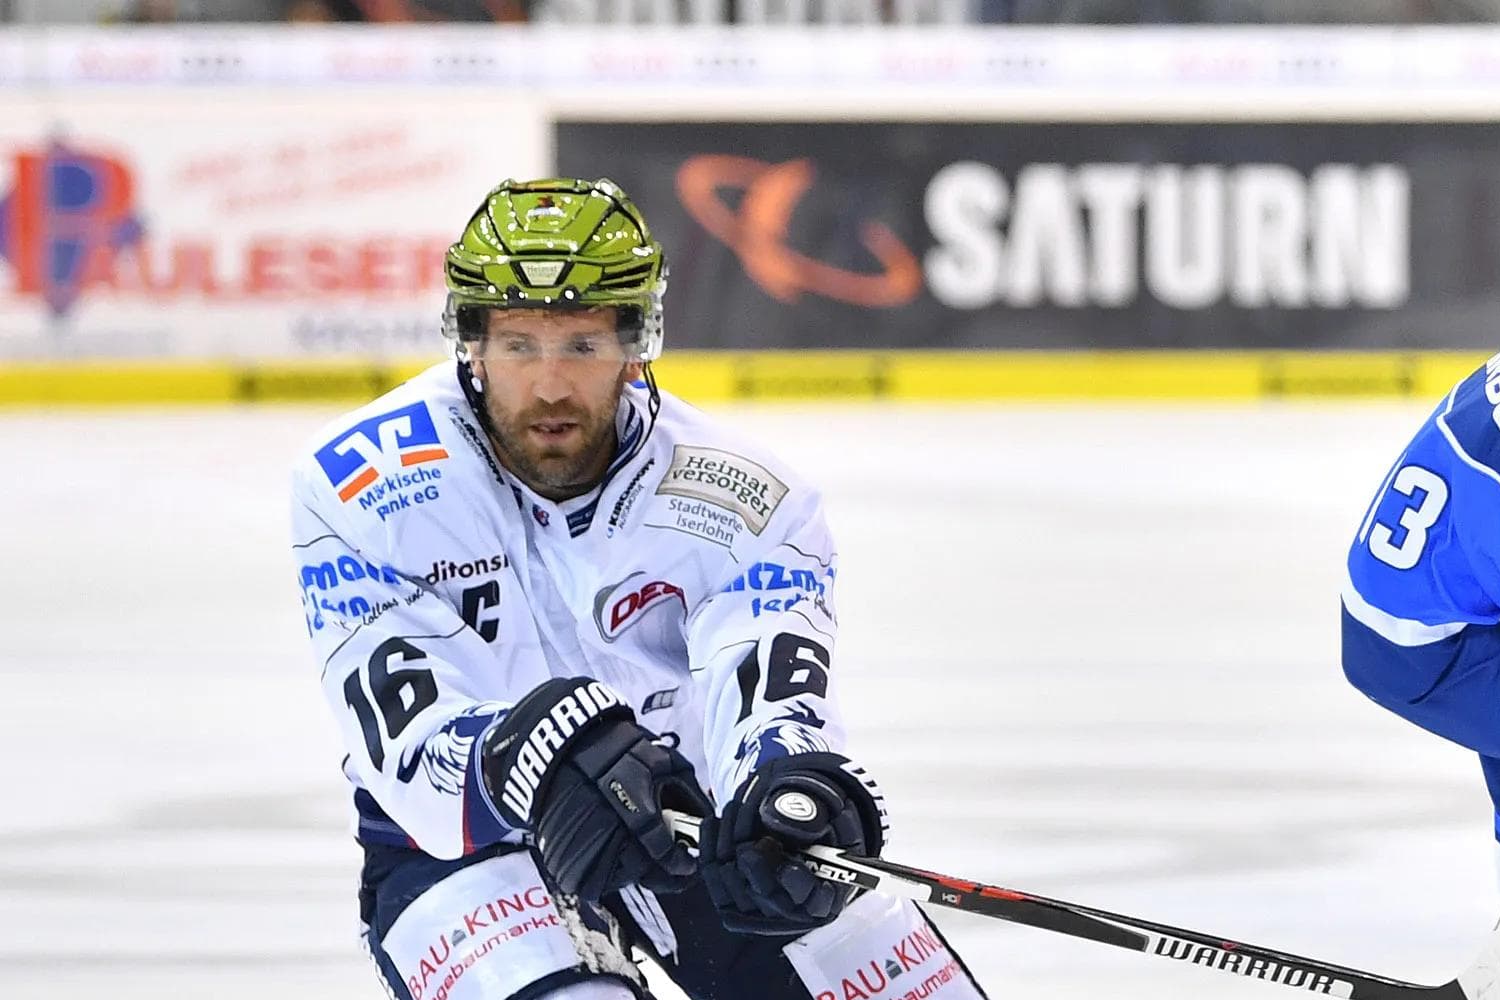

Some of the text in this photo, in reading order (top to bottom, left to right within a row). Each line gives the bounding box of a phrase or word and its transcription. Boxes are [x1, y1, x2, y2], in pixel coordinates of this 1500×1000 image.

[922, 160, 1411, 309] SATURN
[358, 465, 442, 510] Märkische
[413, 485, 440, 505] eG
[672, 467, 770, 518] versorger
[685, 455, 769, 498] Heimat
[676, 514, 735, 545] Iserlohn
[462, 580, 500, 643] C
[343, 636, 439, 774] 16
[734, 632, 830, 727] 16
[463, 886, 550, 936] KING
[1155, 936, 1334, 995] WARRIOR
